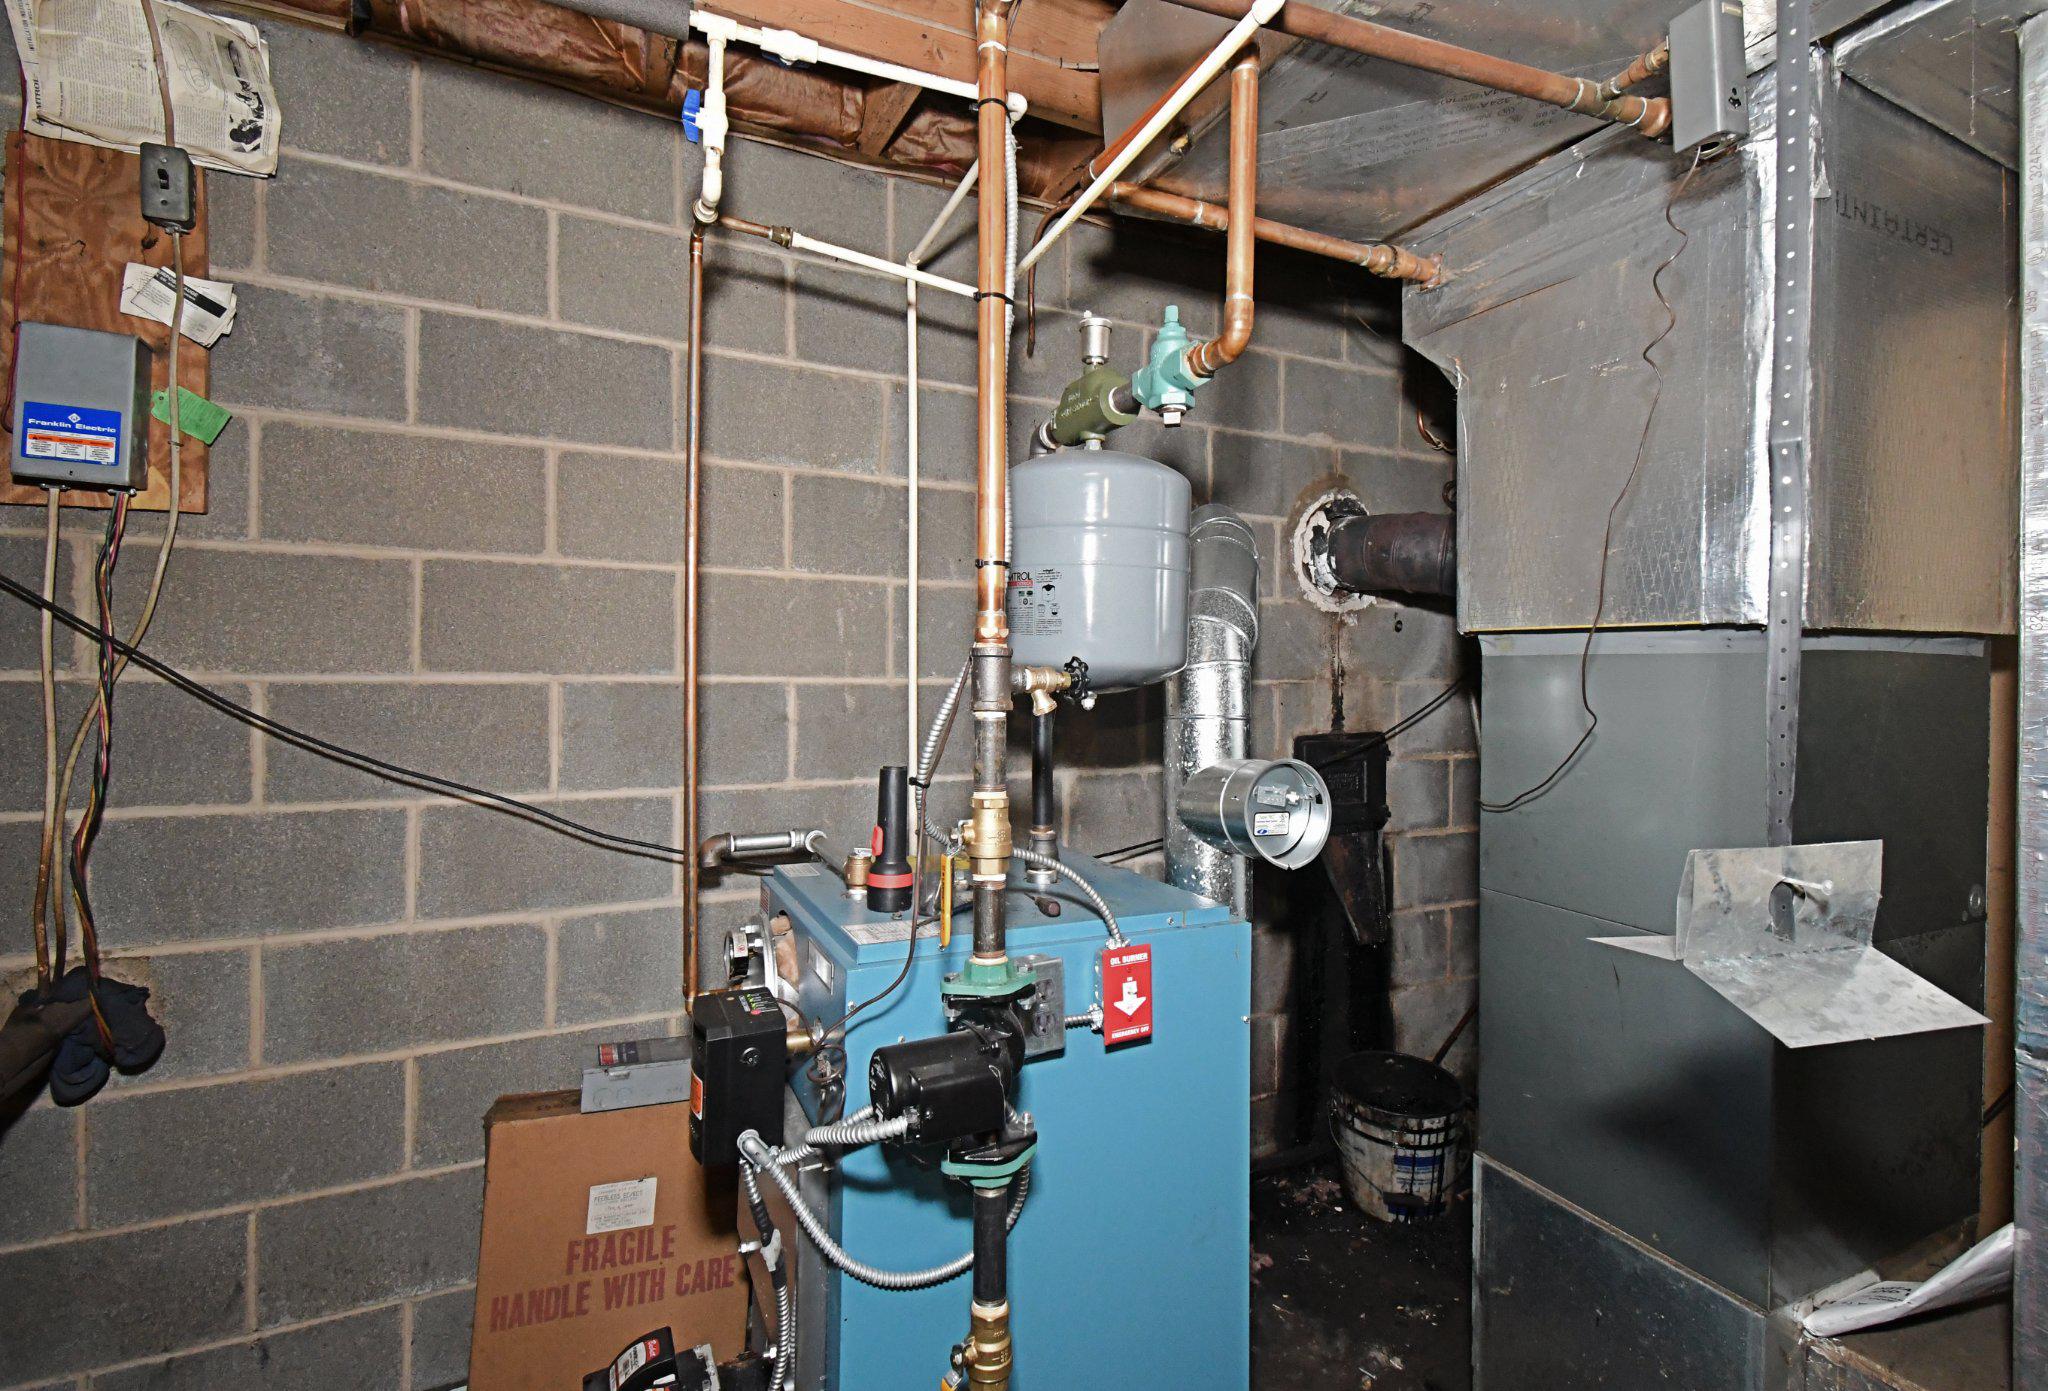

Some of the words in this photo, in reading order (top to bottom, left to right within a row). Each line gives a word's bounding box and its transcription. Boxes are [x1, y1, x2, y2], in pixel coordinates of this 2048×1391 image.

[28, 418, 71, 429] Franklin
[75, 423, 116, 433] Electric
[1110, 957, 1121, 966] OIL
[1122, 952, 1148, 964] BURNER
[1111, 1028, 1140, 1039] EMERGENCY
[1140, 1026, 1149, 1034] OFF
[566, 1225, 677, 1275] FRAGILE
[490, 1281, 592, 1333] HANDLE
[603, 1266, 665, 1311] WITH
[675, 1253, 737, 1297] CARE
